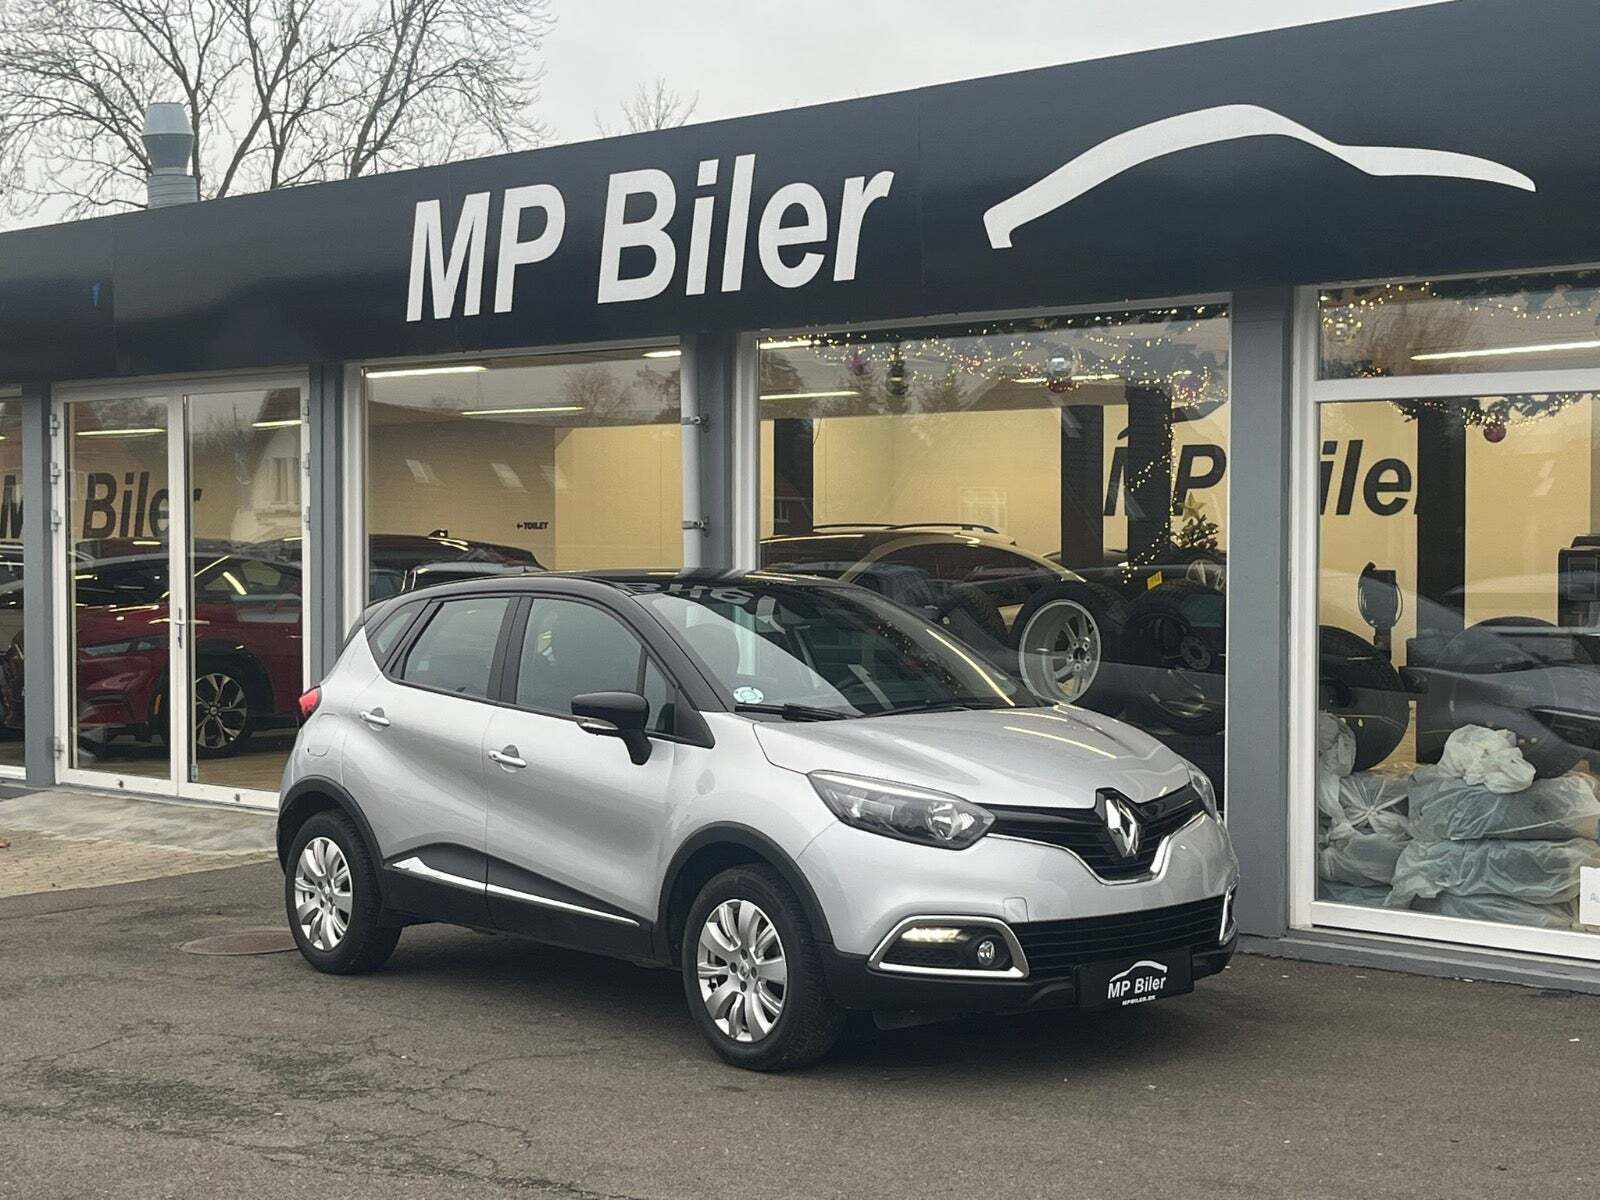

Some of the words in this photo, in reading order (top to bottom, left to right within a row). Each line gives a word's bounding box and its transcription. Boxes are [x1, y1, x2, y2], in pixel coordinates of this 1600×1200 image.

[406, 183, 566, 322] MP
[597, 153, 895, 304] Biler
[1319, 439, 1420, 517] ile
[523, 521, 549, 530] TOILET
[1107, 980, 1131, 999] MP
[1134, 976, 1167, 994] Biler
